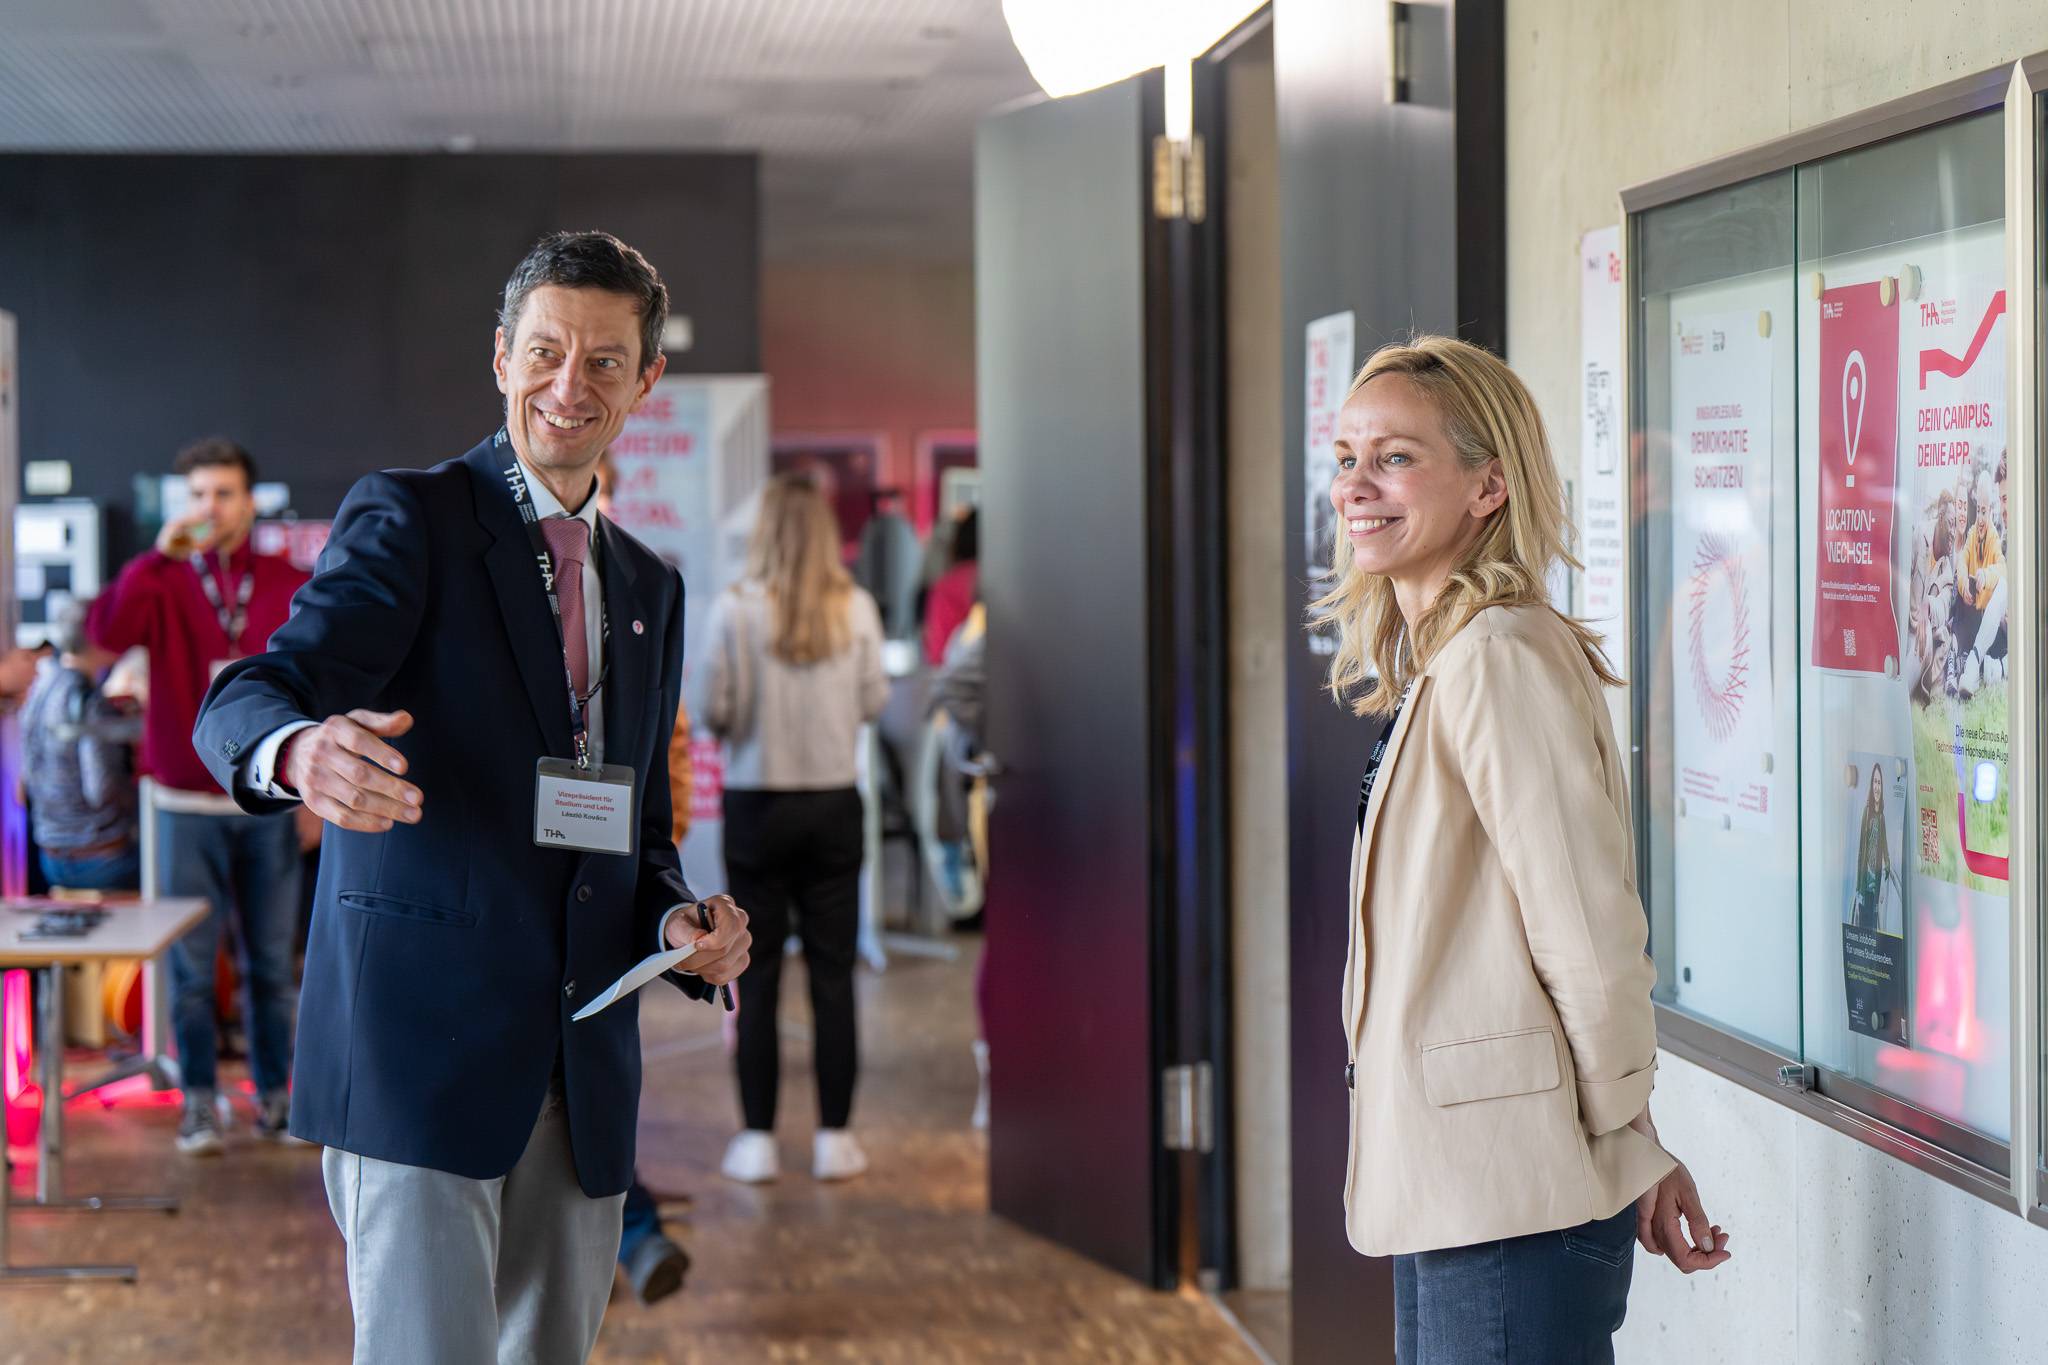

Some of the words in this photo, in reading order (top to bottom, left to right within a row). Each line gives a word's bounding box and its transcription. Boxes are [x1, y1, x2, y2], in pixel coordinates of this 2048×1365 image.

[1920, 302, 1940, 328] THA
[1918, 408, 1941, 432] DEIN
[1943, 403, 1993, 431] CAMPUS.
[1691, 429, 1748, 454] DEMOKRATIE
[1917, 442, 1946, 467] DEINE
[1947, 441, 1971, 465] APP.
[503, 463, 526, 503] THA
[1825, 508, 1876, 532] LOCATION-
[1825, 541, 1873, 565] WECHSEL
[536, 551, 554, 591] THA
[1955, 725, 1964, 737] Die
[1965, 729, 1978, 740] neue
[1979, 727, 2000, 743] Campus
[1936, 739, 1965, 756] Technischen
[1965, 744, 1996, 760] Hochschule
[555, 799, 582, 809] Studium
[596, 804, 615, 812] Lehre
[558, 790, 602, 802] Vizepräsident
[543, 828, 566, 839] THA
